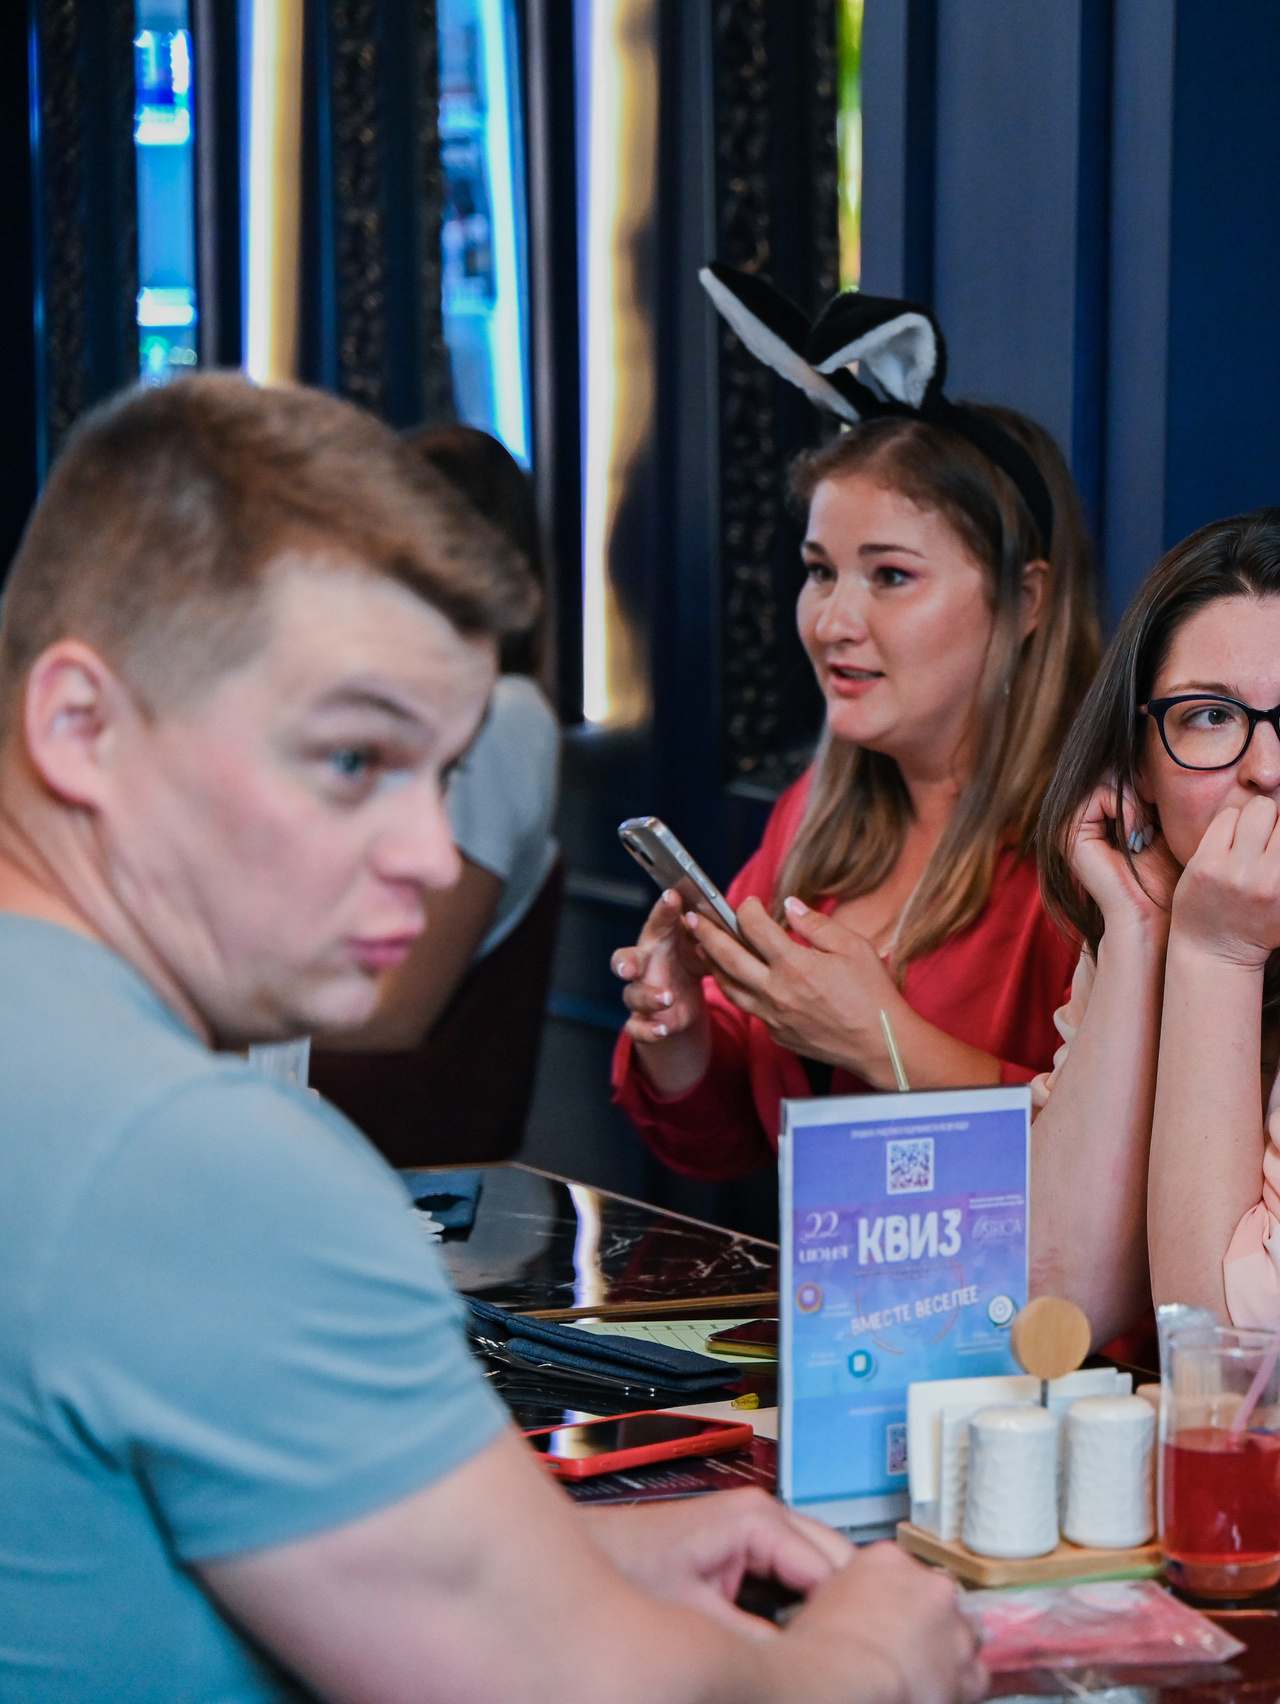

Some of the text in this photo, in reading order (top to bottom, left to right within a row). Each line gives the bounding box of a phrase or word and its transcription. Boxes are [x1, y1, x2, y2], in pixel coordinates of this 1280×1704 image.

[804, 1211, 839, 1239] 22
[858, 1208, 962, 1265] КВИЗ
[851, 1304, 911, 1337] ВМЕСТЕ
[915, 1285, 979, 1318] ВЕСЕЛЕЕ
